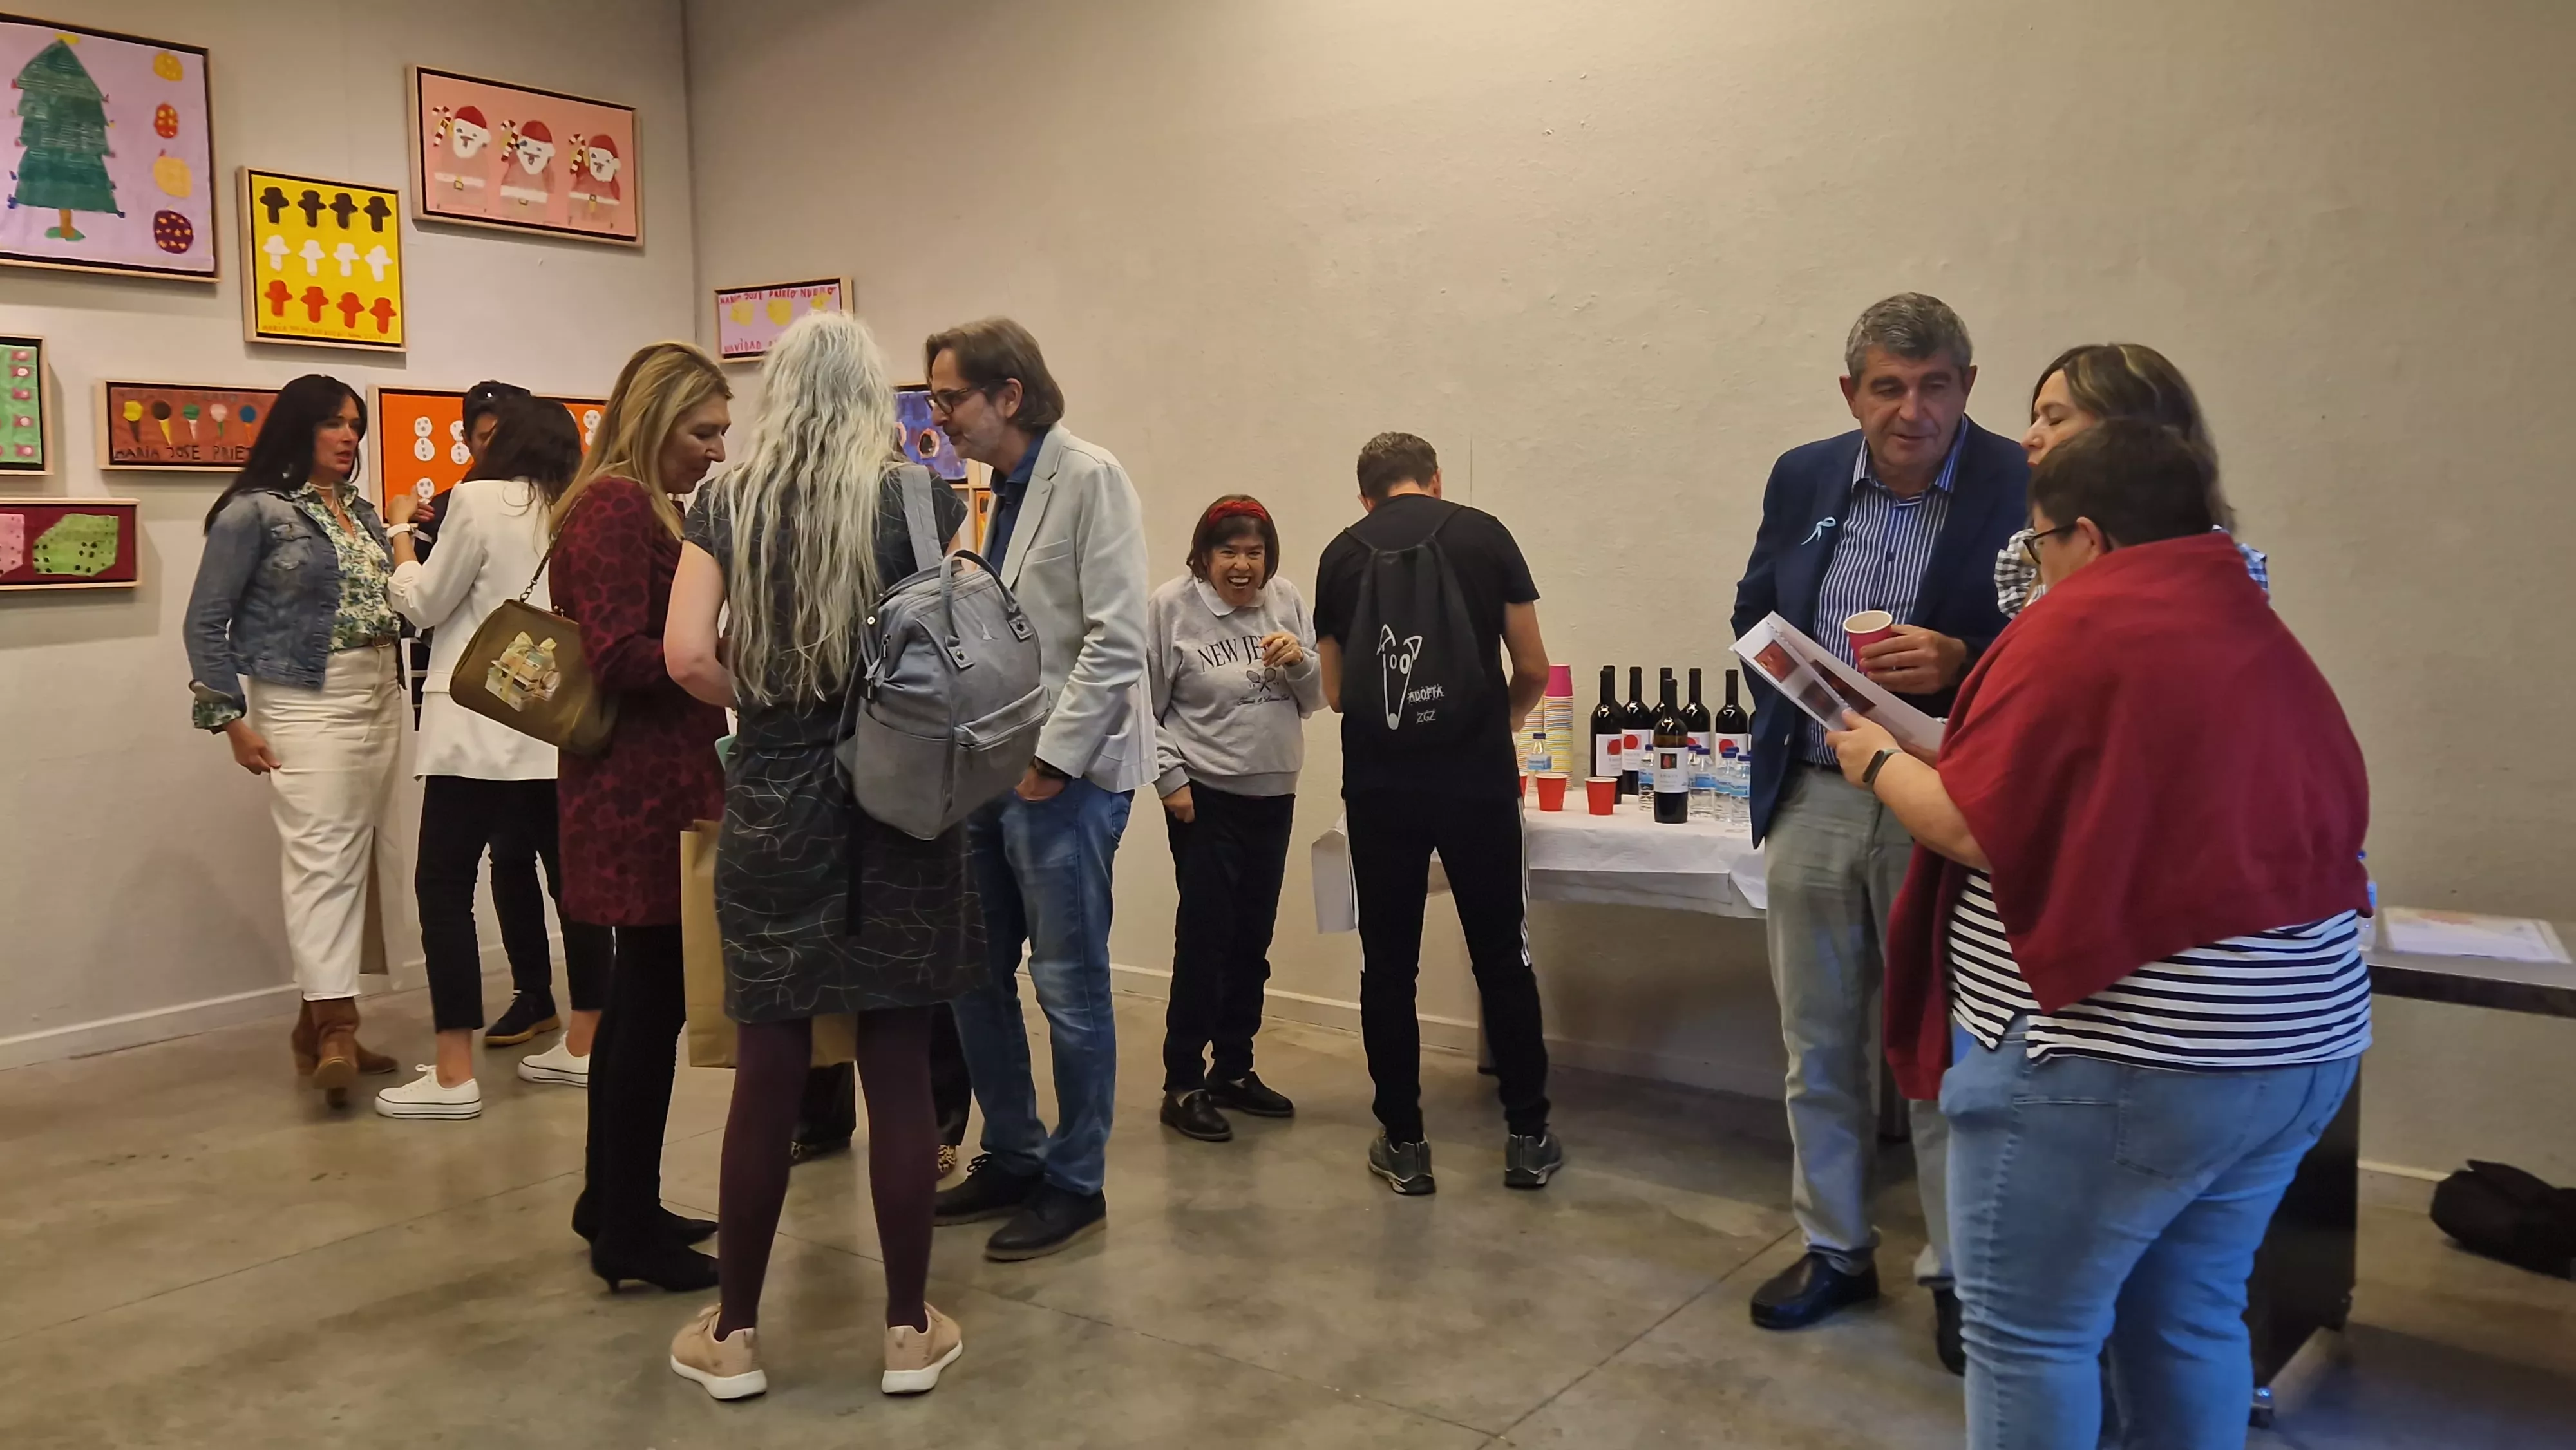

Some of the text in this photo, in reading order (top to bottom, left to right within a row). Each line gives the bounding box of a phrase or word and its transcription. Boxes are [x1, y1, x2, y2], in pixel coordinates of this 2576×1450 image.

[115, 446, 160, 459] MARIA
[166, 445, 201, 460] JOSE
[1197, 639, 1238, 672] NEW
[1407, 684, 1444, 705] ADOPTA
